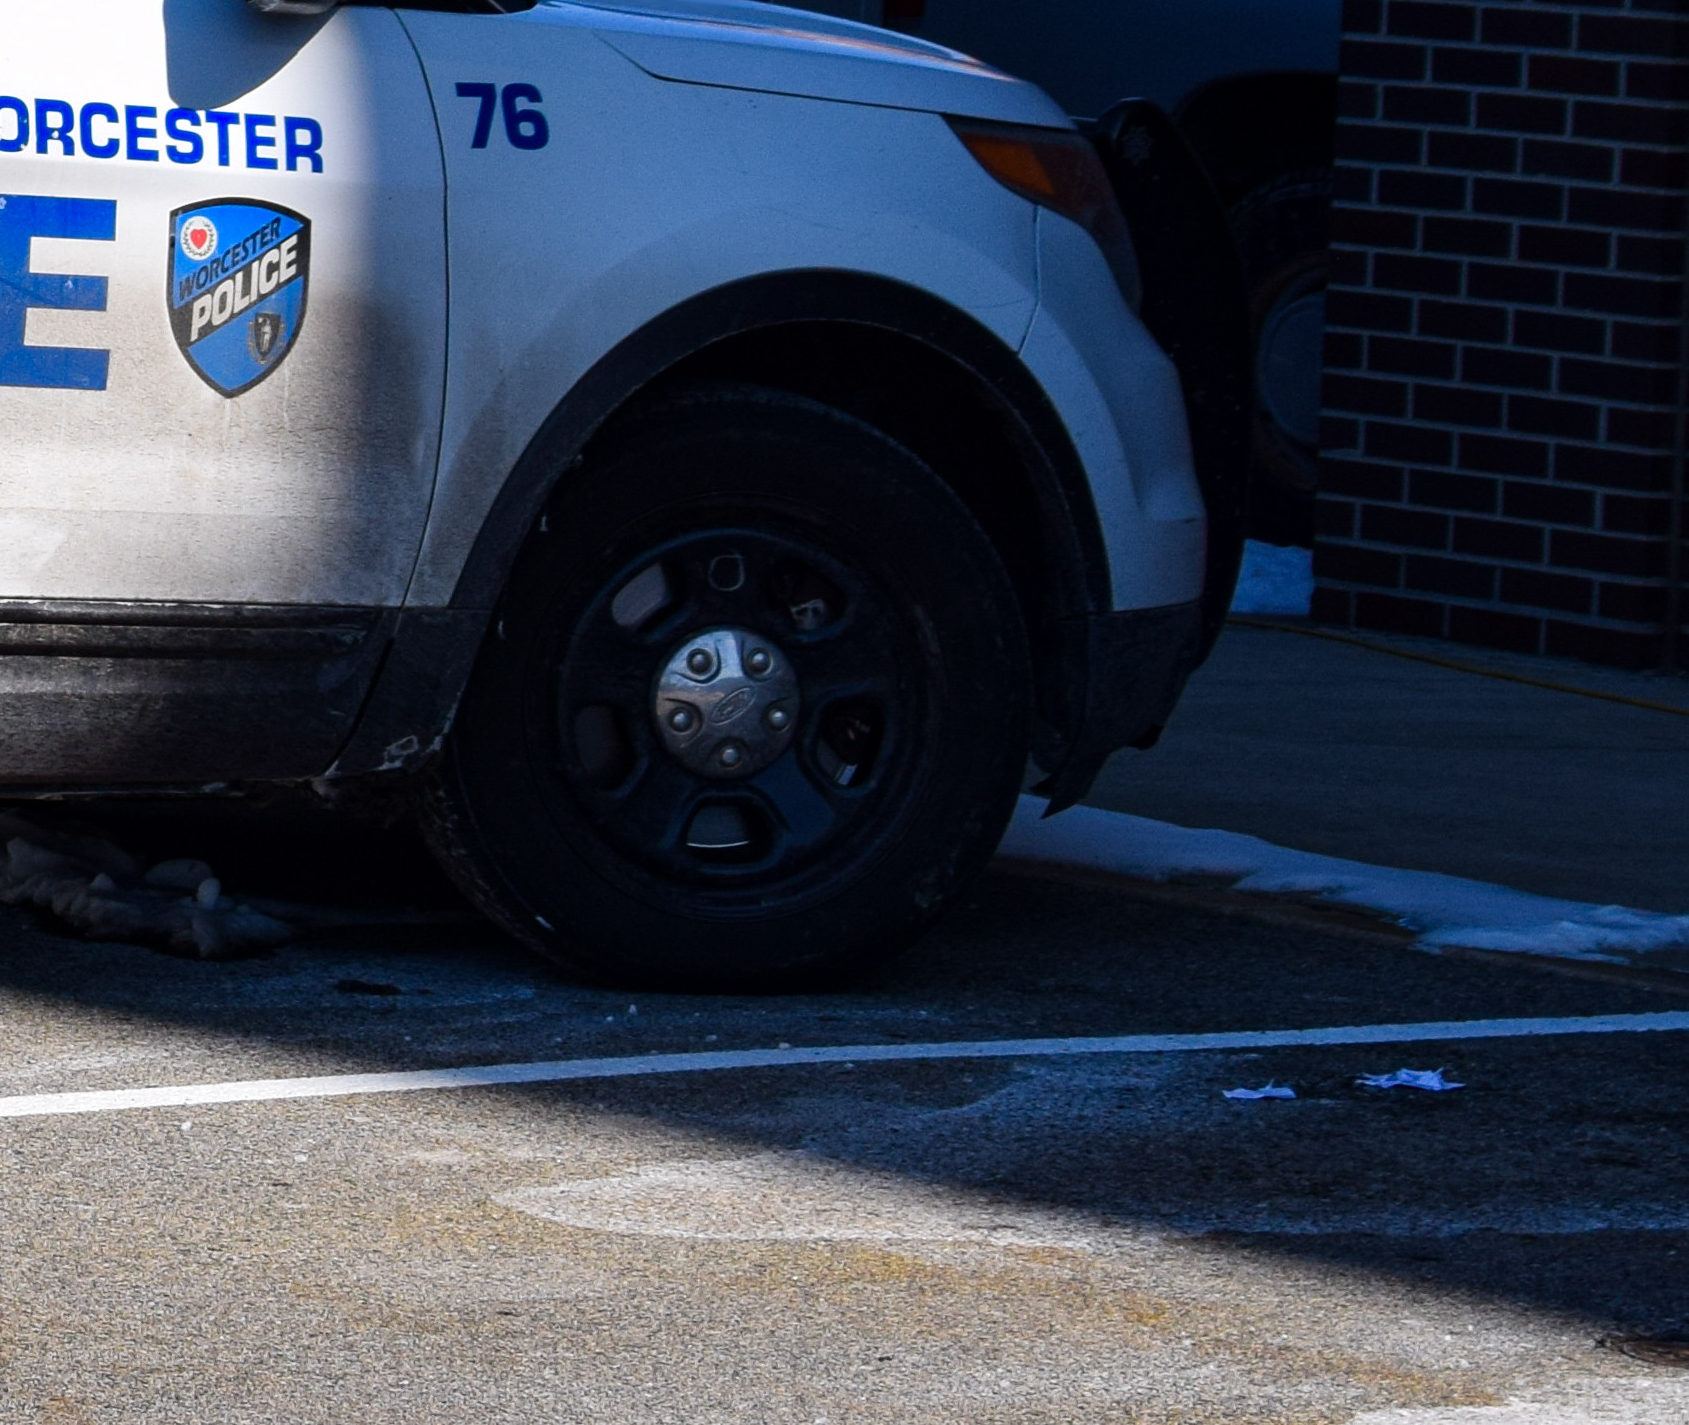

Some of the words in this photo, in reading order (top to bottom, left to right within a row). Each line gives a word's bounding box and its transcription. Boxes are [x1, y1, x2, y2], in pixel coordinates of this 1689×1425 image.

[455, 82, 550, 151] 76
[178, 216, 282, 302] WORCESTER
[190, 234, 298, 342] POLICE
